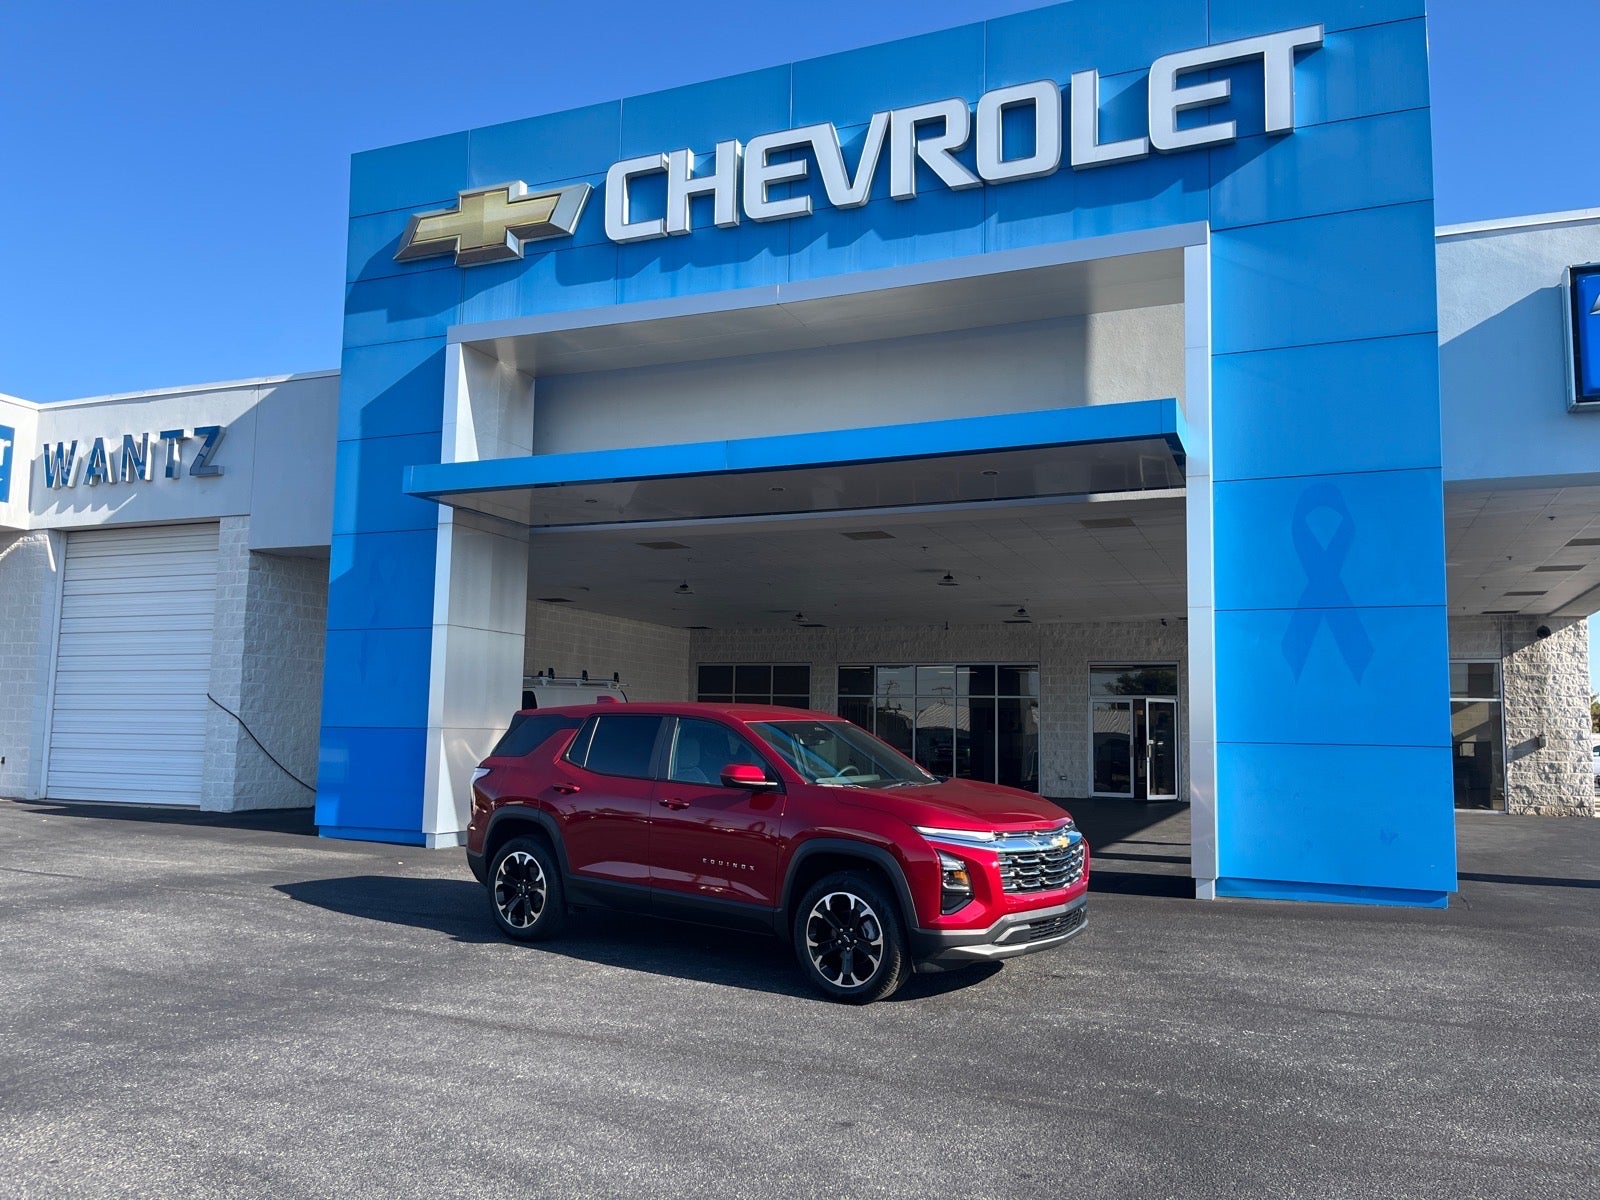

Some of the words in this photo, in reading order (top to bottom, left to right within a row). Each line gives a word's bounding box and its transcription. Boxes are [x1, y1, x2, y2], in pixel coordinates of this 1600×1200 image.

[604, 25, 1324, 244] CHEVROLET
[43, 425, 226, 490] WANTZ
[702, 857, 755, 871] EQUINOX
